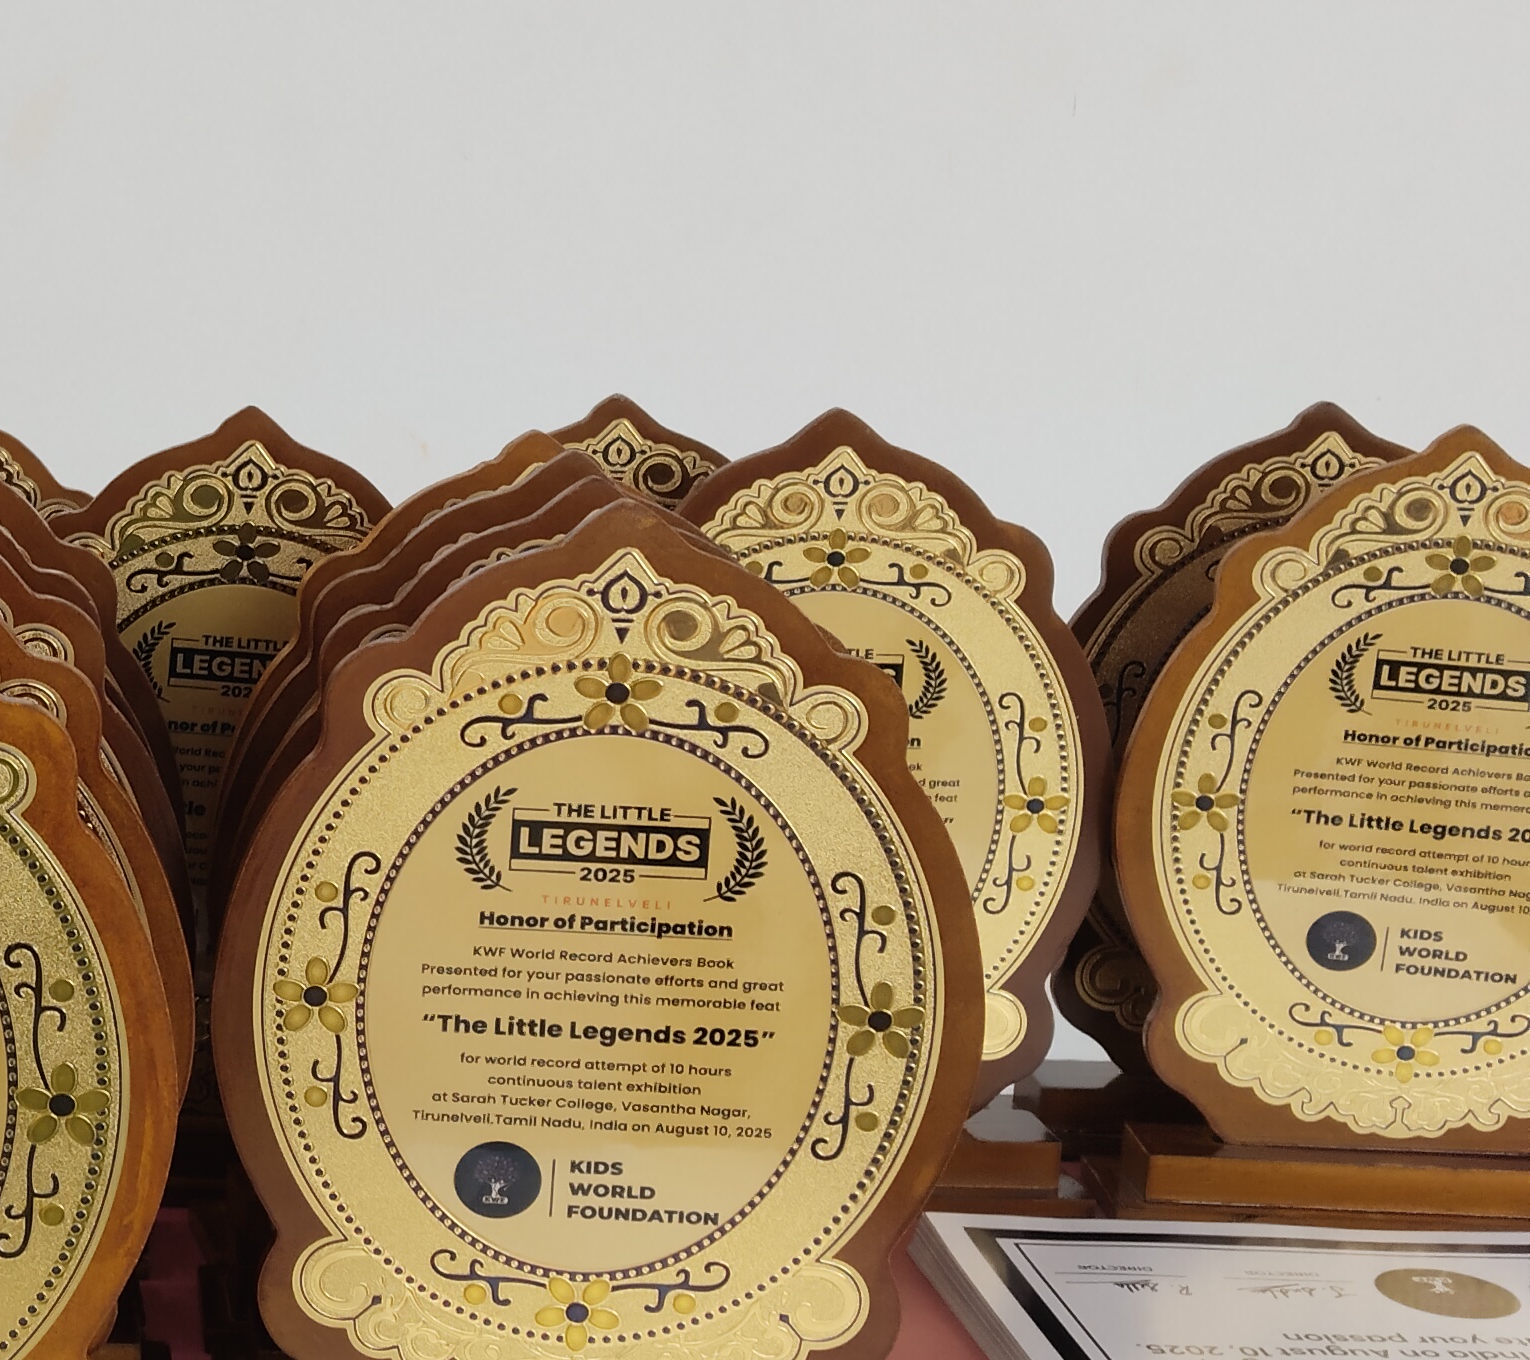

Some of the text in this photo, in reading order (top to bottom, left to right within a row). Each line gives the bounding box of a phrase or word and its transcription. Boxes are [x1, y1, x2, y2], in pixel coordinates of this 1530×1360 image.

[1409, 645, 1505, 667] THE LITTLE
[1379, 664, 1527, 698] LEGENDS
[1425, 696, 1472, 713] 2025
[551, 801, 672, 823] THE LITTLE
[517, 827, 701, 862] LEGENDS
[578, 865, 635, 884] 2025
[478, 909, 734, 940] Honor of Participation
[421, 1012, 776, 1048] “The Little Legends 2025”
[568, 1158, 624, 1176] KIDS
[567, 1181, 656, 1200] WORLD
[566, 1204, 721, 1228] FOUNDATION
